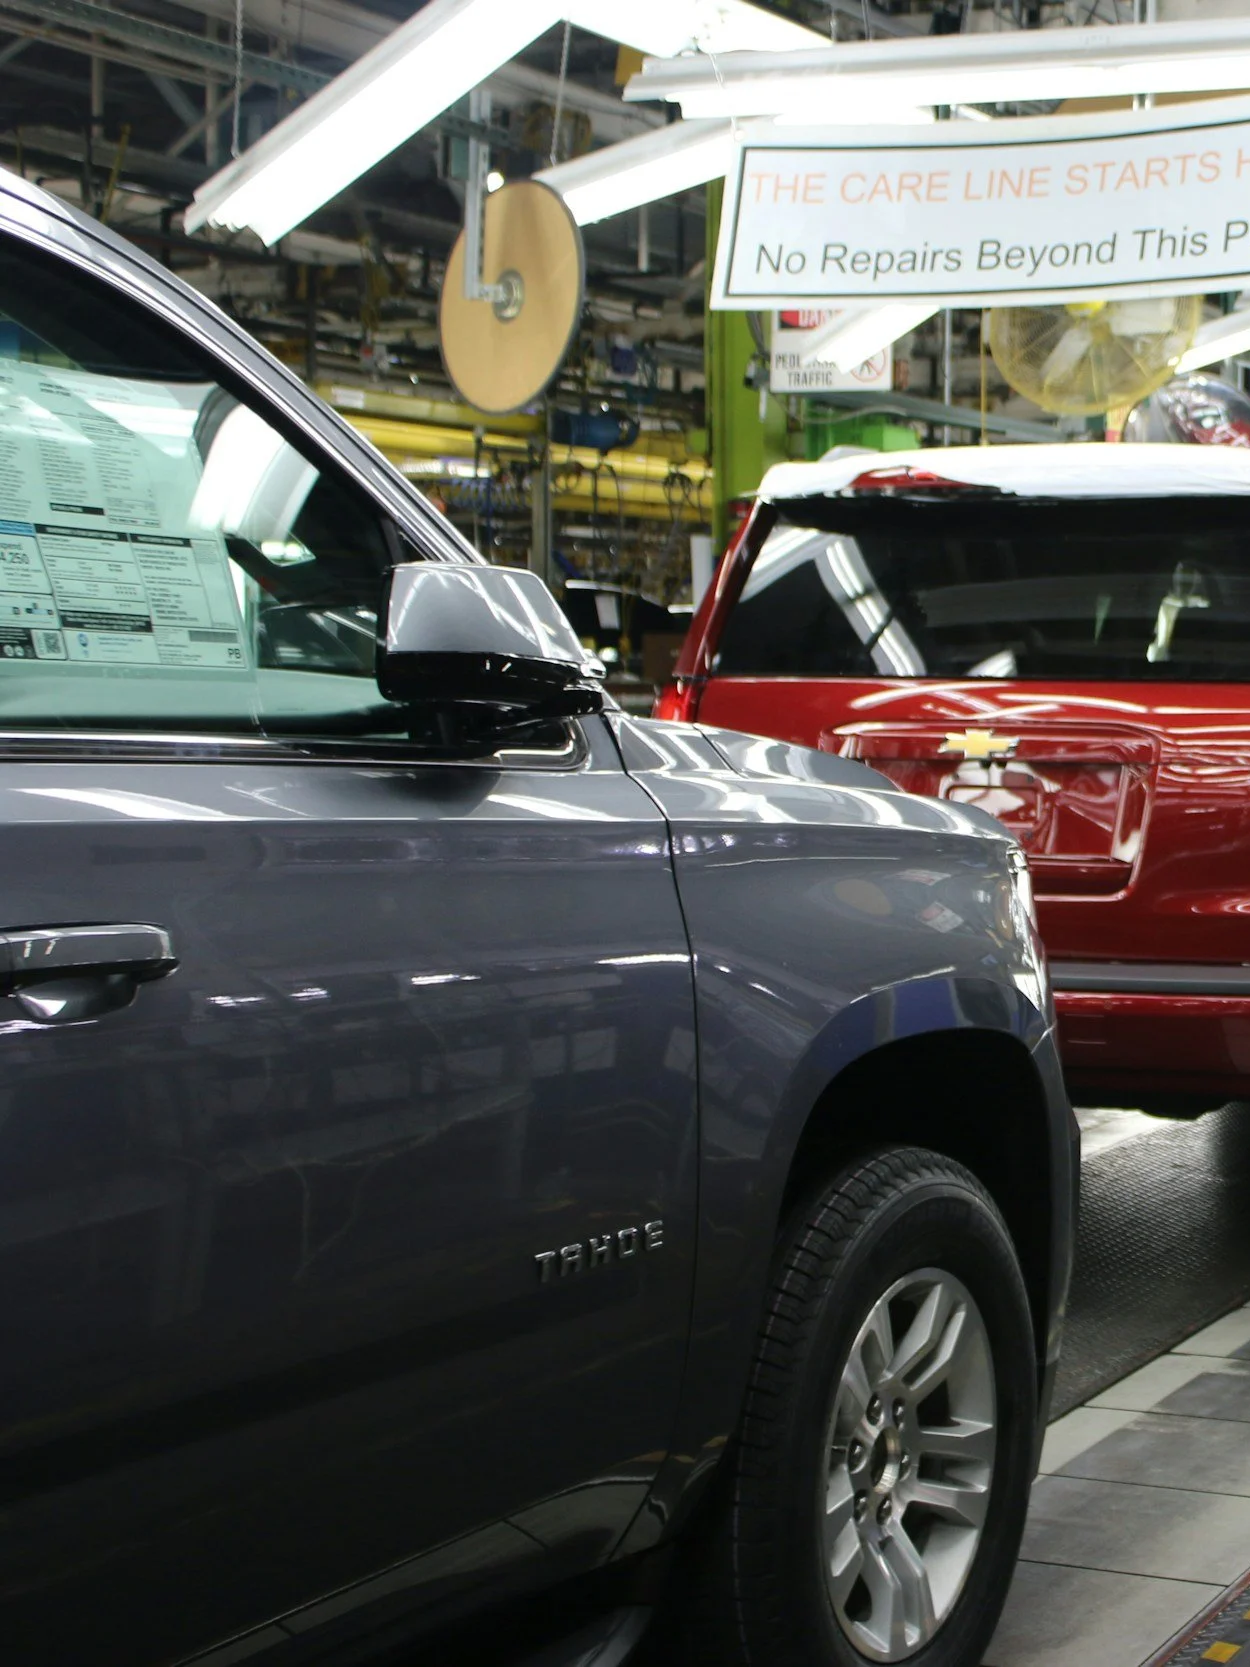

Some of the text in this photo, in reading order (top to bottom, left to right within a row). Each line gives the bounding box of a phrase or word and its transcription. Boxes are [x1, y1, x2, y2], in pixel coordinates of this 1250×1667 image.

[749, 172, 827, 204] THE
[839, 171, 950, 204] CARE
[963, 166, 1051, 201] LINE
[1064, 150, 1222, 195] STARTS
[755, 243, 806, 275] No
[820, 241, 962, 281] Repairs
[976, 232, 1117, 277] Beyond
[1132, 225, 1208, 261] This
[787, 370, 832, 387] TRAFFIC
[534, 1220, 663, 1283] TAHOE
